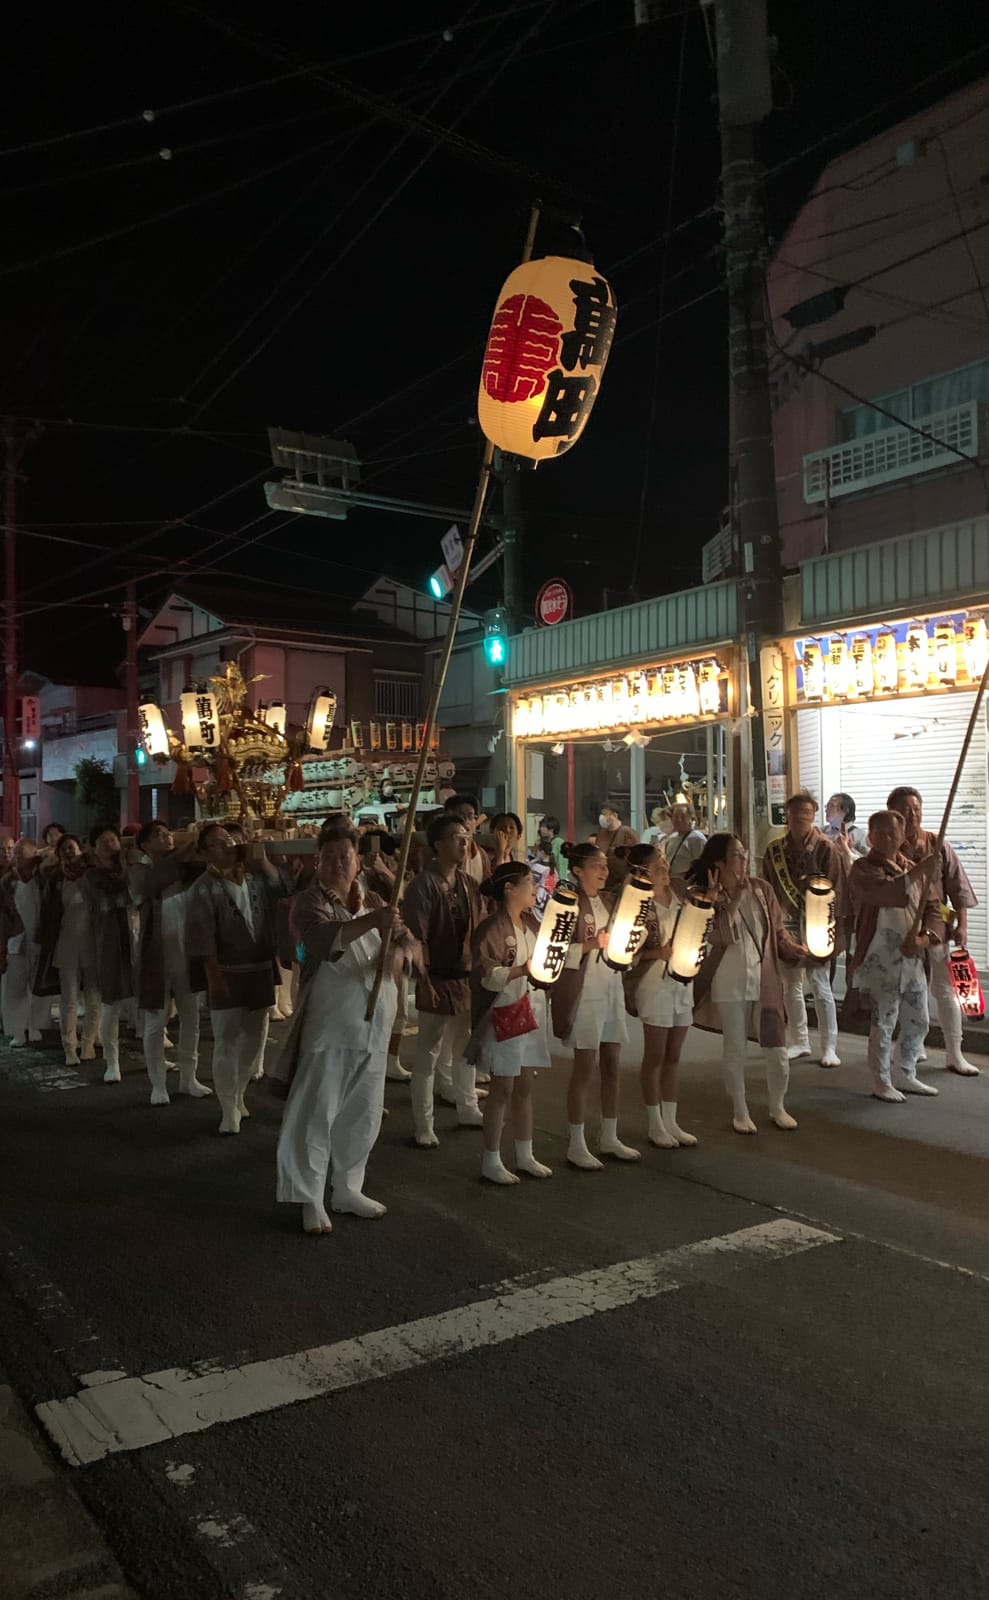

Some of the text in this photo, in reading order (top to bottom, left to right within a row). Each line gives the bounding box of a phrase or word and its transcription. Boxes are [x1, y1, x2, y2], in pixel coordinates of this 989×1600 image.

[766, 674, 783, 747] クリニック
